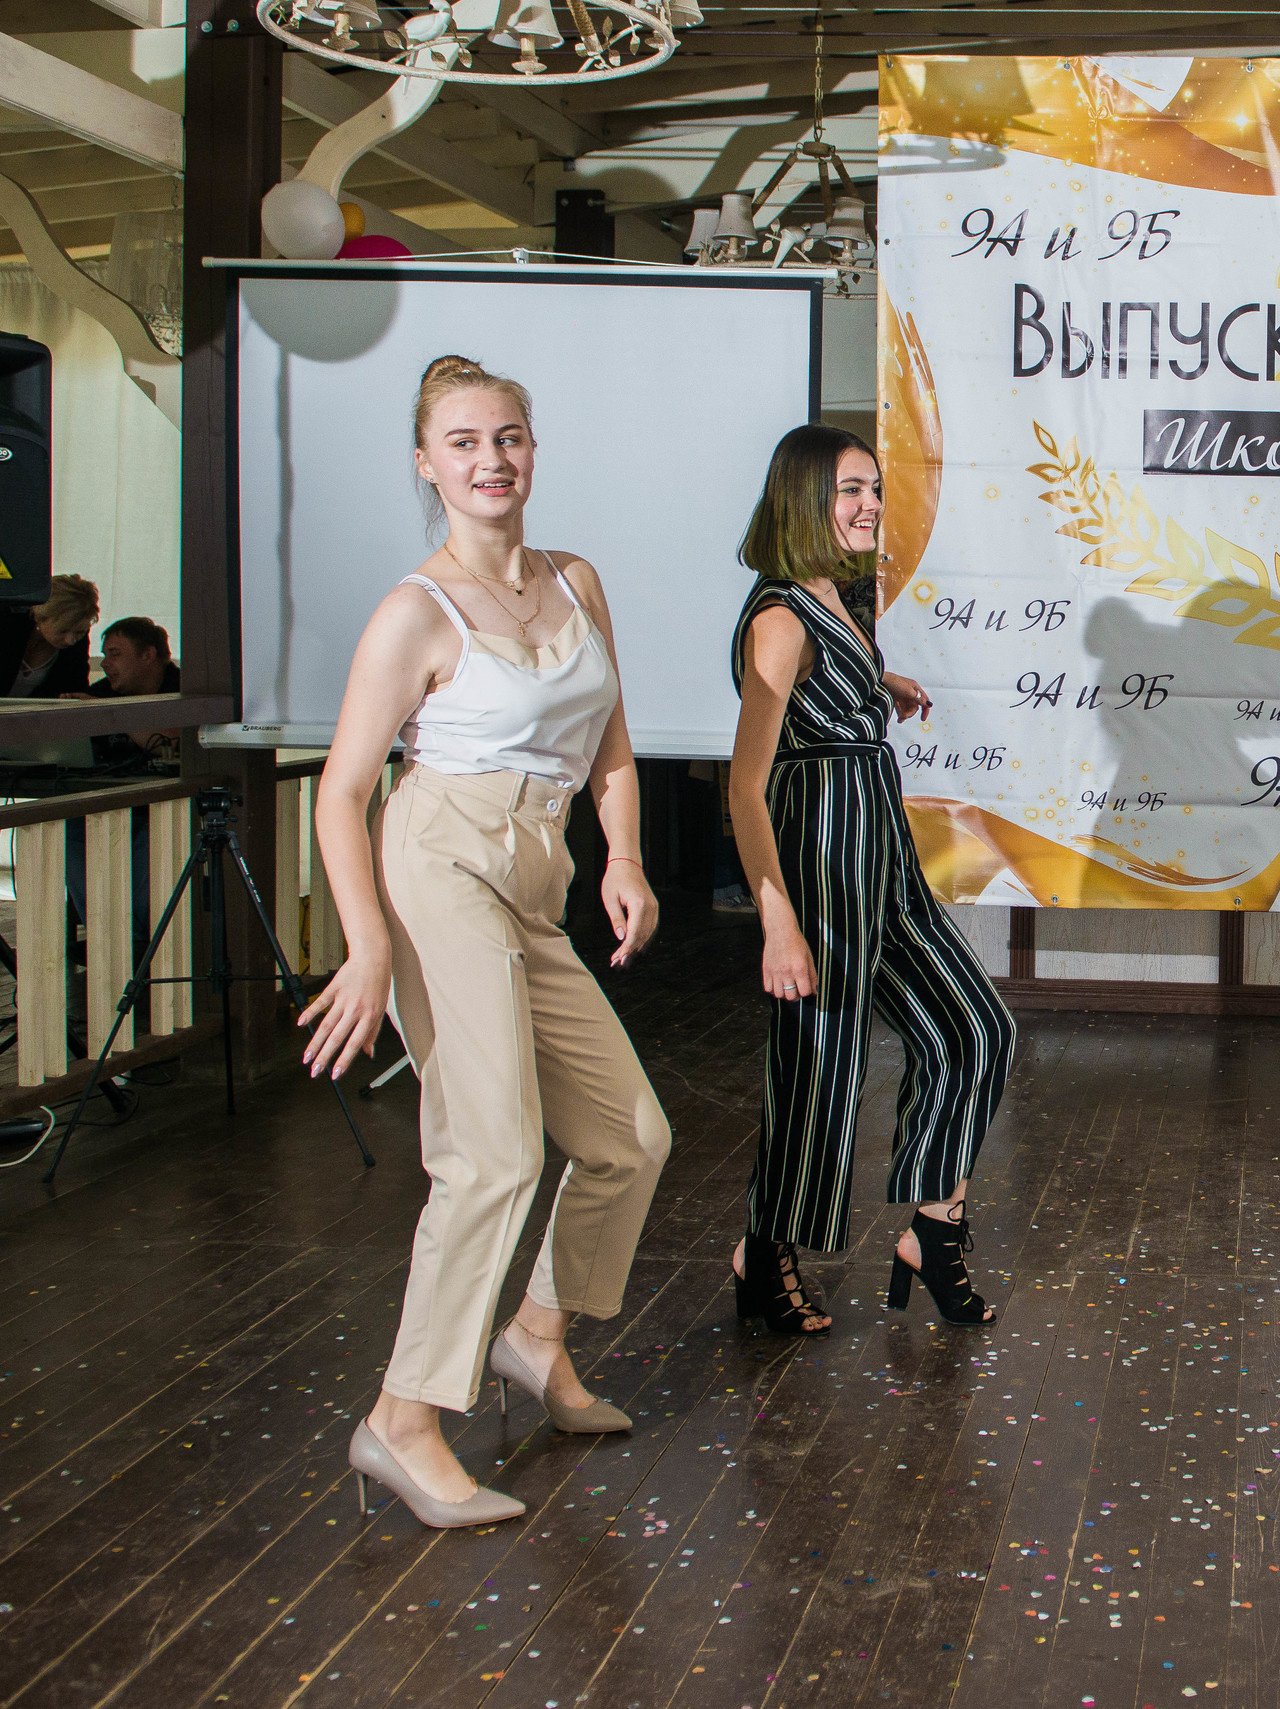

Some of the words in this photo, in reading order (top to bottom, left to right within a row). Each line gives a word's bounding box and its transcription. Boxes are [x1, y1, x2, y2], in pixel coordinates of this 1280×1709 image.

[951, 208, 1027, 259] 9А
[1044, 228, 1081, 261] и
[1098, 210, 1180, 260] 9Б
[929, 598, 976, 630] 9А
[985, 610, 1008, 631] и
[1019, 600, 1071, 631] 9Б
[1009, 672, 1066, 709] 9А
[1076, 686, 1103, 709] и
[1114, 674, 1174, 710] 9Б
[1234, 700, 1264, 720] 9А
[902, 744, 938, 768] 9А
[945, 754, 961, 769] и
[969, 746, 1006, 771] 9Б
[1077, 791, 1107, 810] 9А
[1113, 798, 1128, 811] и
[1135, 792, 1167, 811] 9Б
